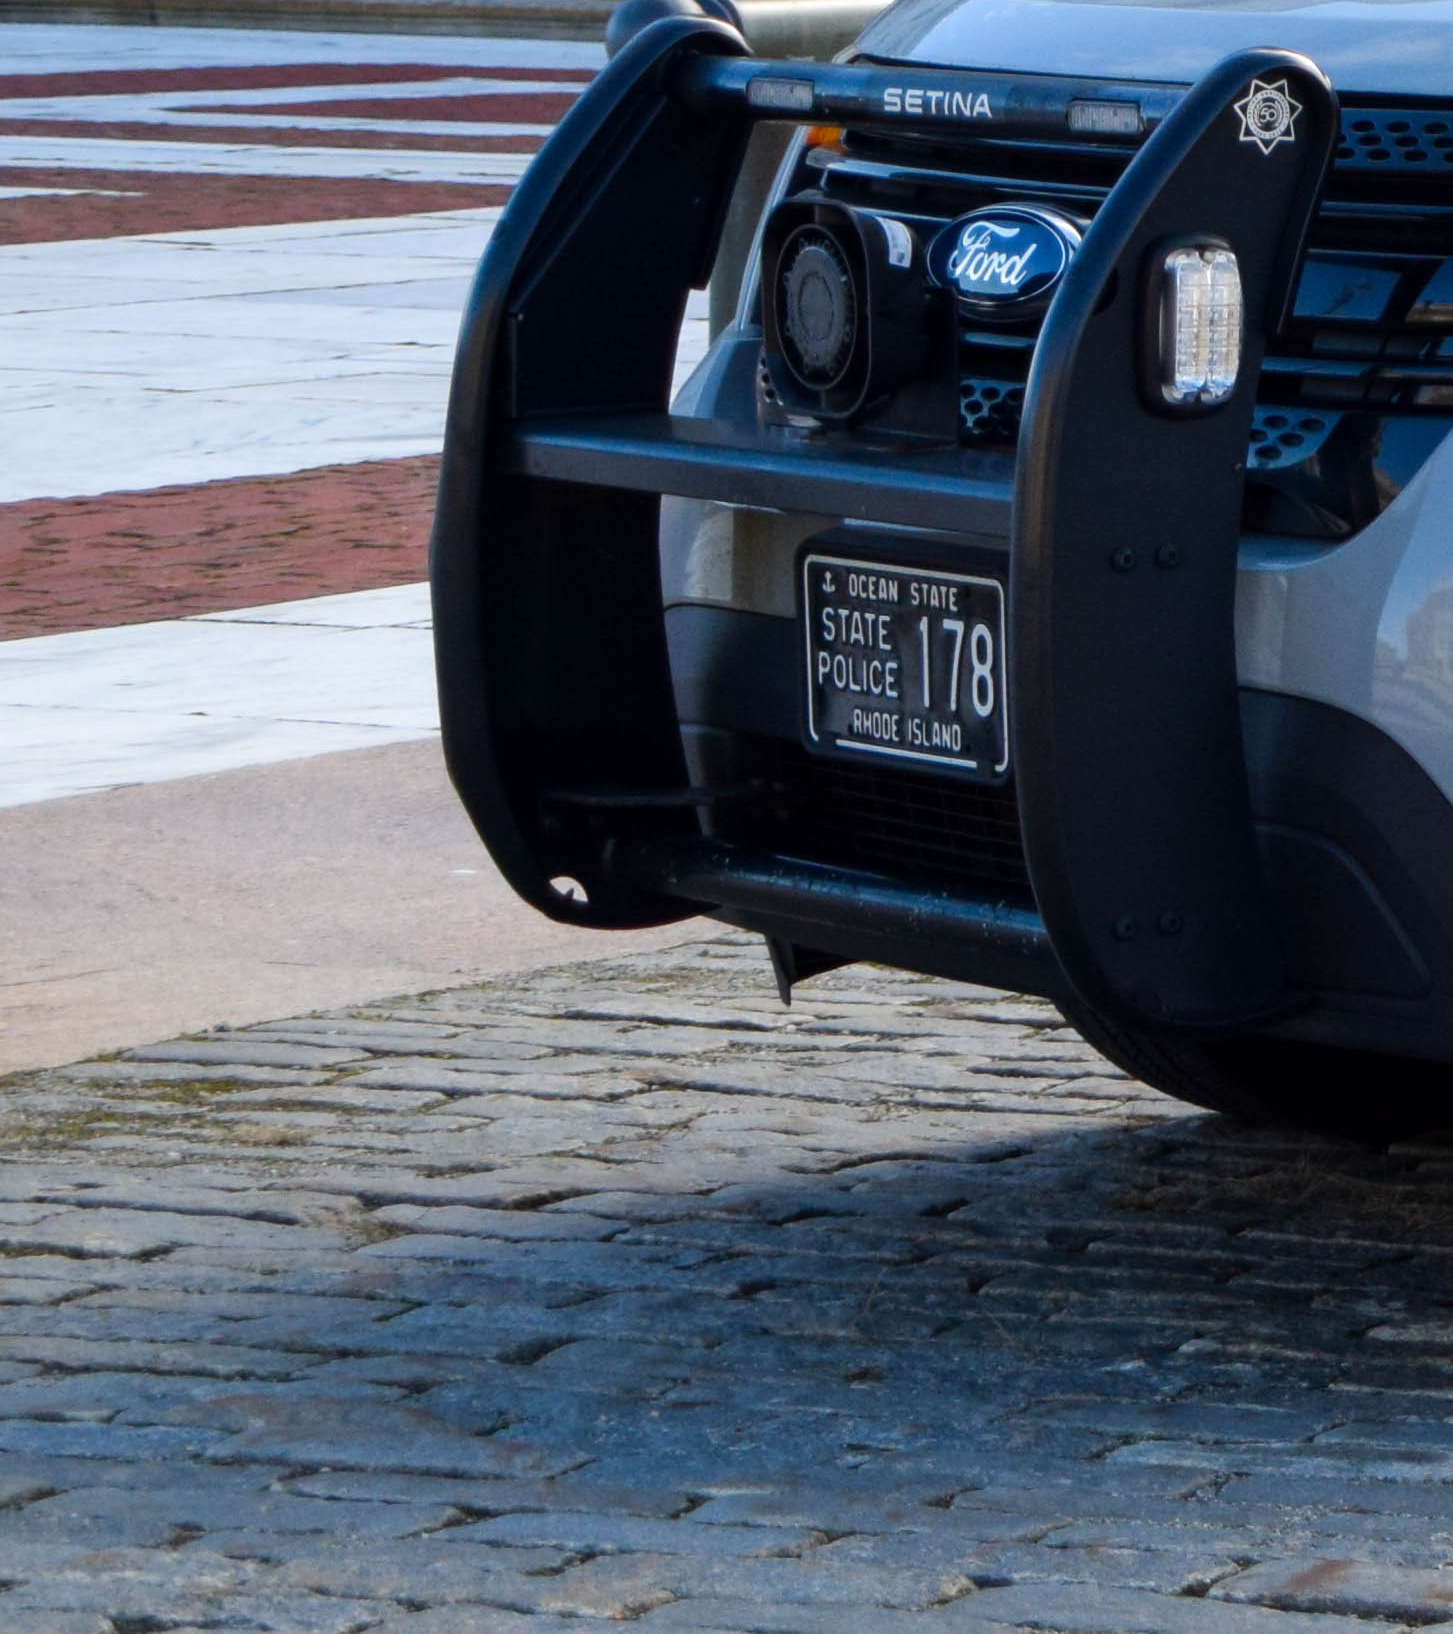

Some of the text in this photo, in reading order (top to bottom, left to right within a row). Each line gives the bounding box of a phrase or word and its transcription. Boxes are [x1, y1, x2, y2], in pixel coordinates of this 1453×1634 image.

[883, 87, 993, 119] SETINA
[948, 220, 1038, 286] Ford
[849, 573, 958, 612] OCEAN STATE
[822, 607, 892, 651] STATE
[818, 651, 898, 698] POLICE
[920, 615, 994, 718] 178
[853, 708, 962, 752] RHODE ISLAND
